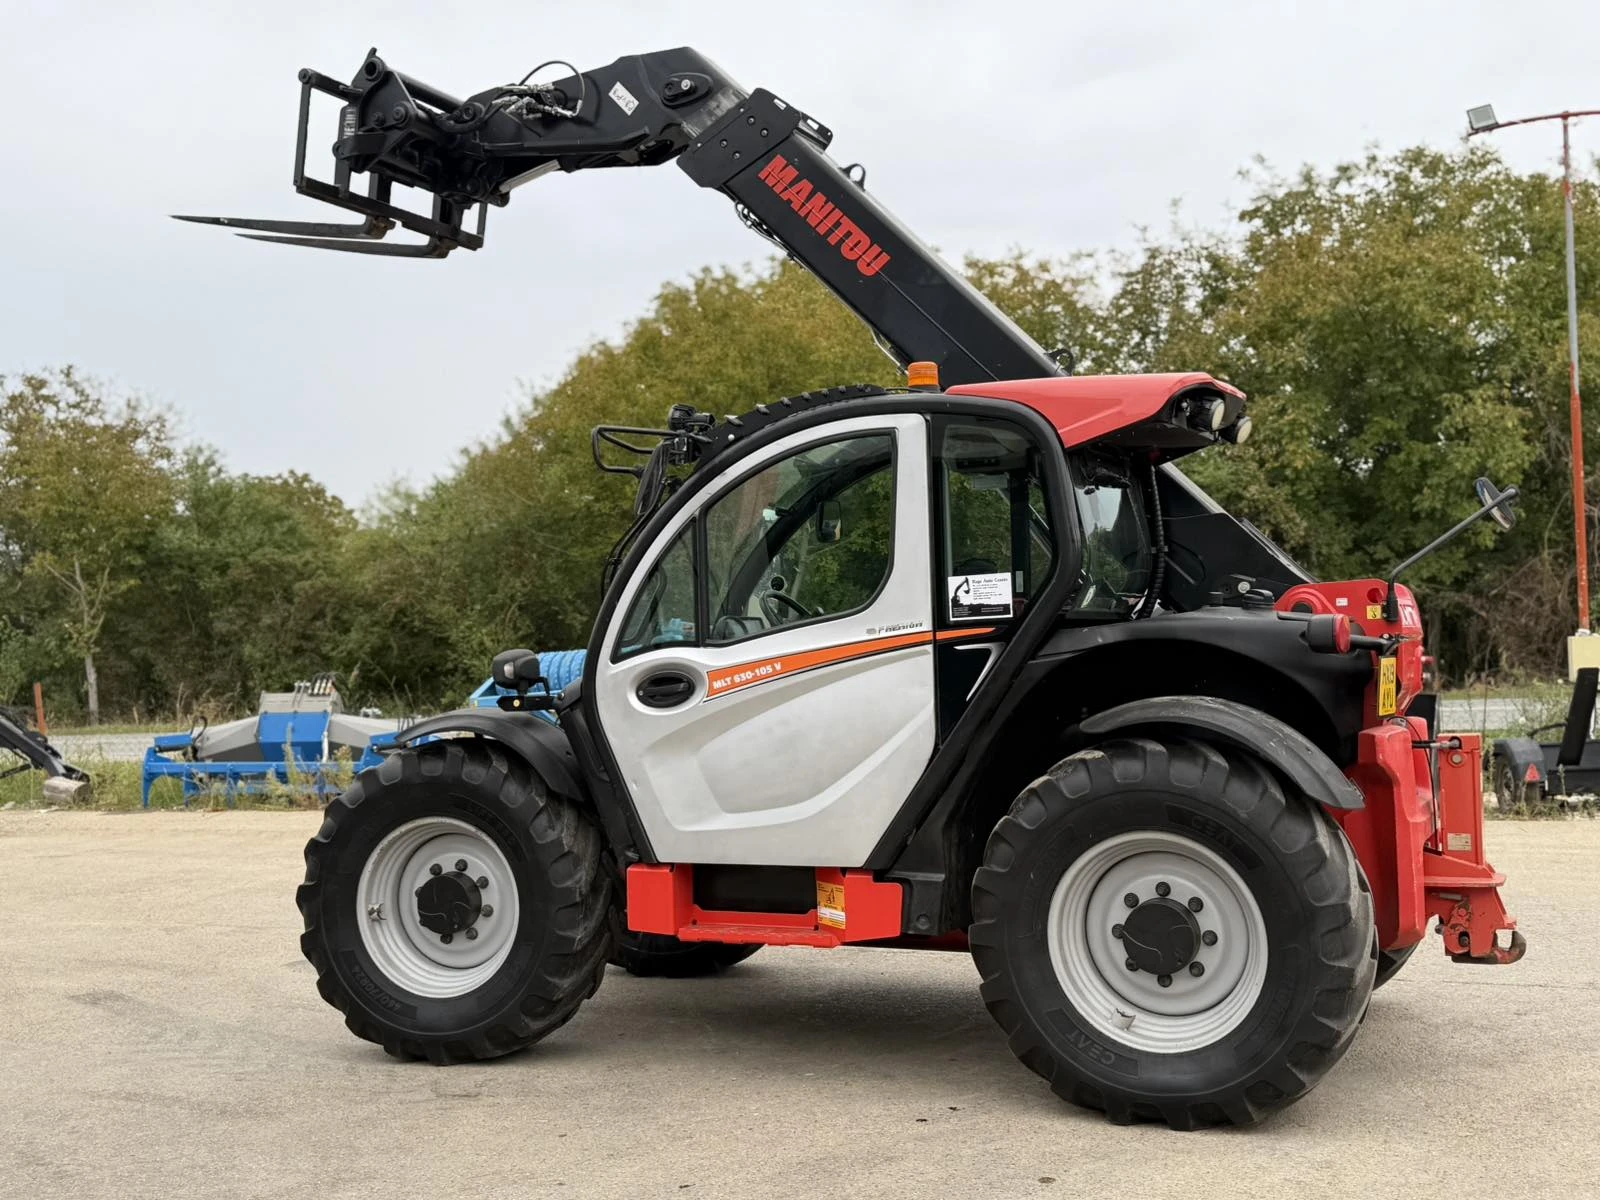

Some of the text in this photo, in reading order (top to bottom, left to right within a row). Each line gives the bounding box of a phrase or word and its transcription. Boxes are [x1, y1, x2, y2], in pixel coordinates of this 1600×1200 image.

[758, 154, 891, 276] MANITOU
[712, 661, 782, 689] MLT 630-105 V
[1064, 1028, 1116, 1065] CEAT
